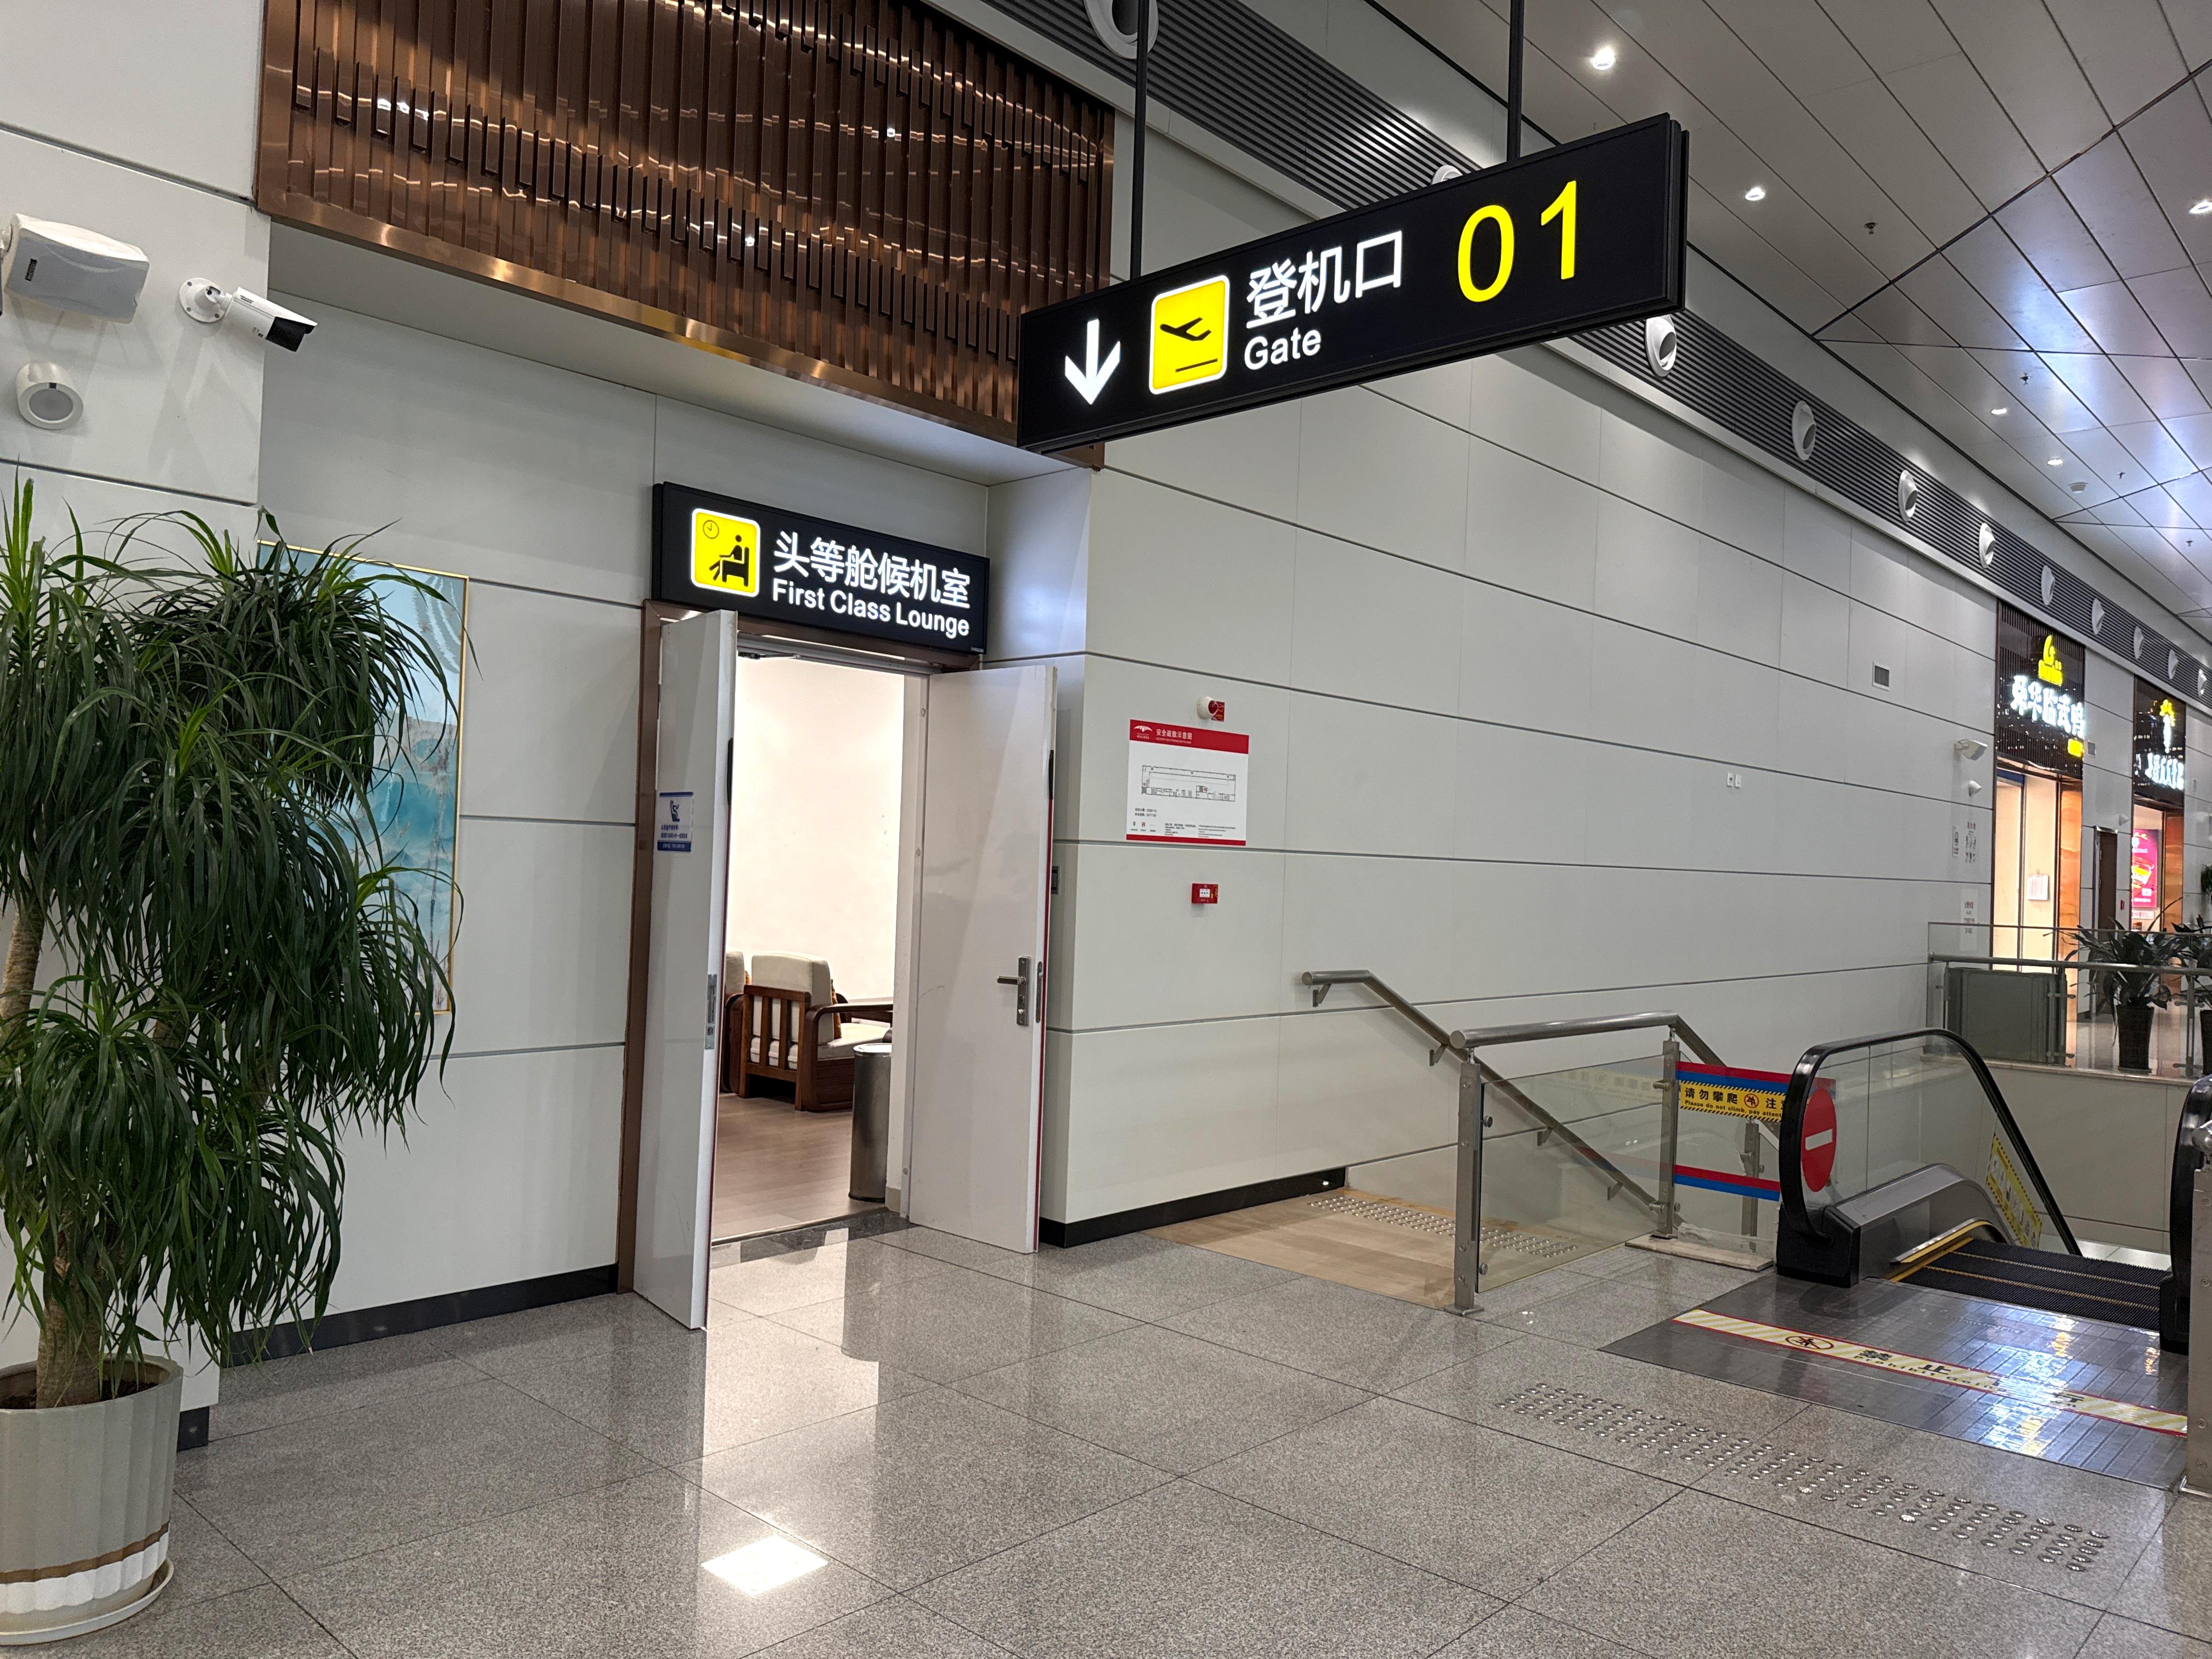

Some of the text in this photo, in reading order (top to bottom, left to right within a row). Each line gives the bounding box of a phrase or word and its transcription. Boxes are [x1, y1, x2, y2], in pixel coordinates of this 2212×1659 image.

[1246, 180, 1578, 329] 登机口 01
[1244, 328, 1322, 370] Gate
[773, 531, 970, 609] 头等舱候机室
[773, 579, 970, 639] First Class Lounge
[1684, 1087, 1784, 1110] 请勿攀爬 注
[1854, 1356, 1936, 1376] Prohibit
